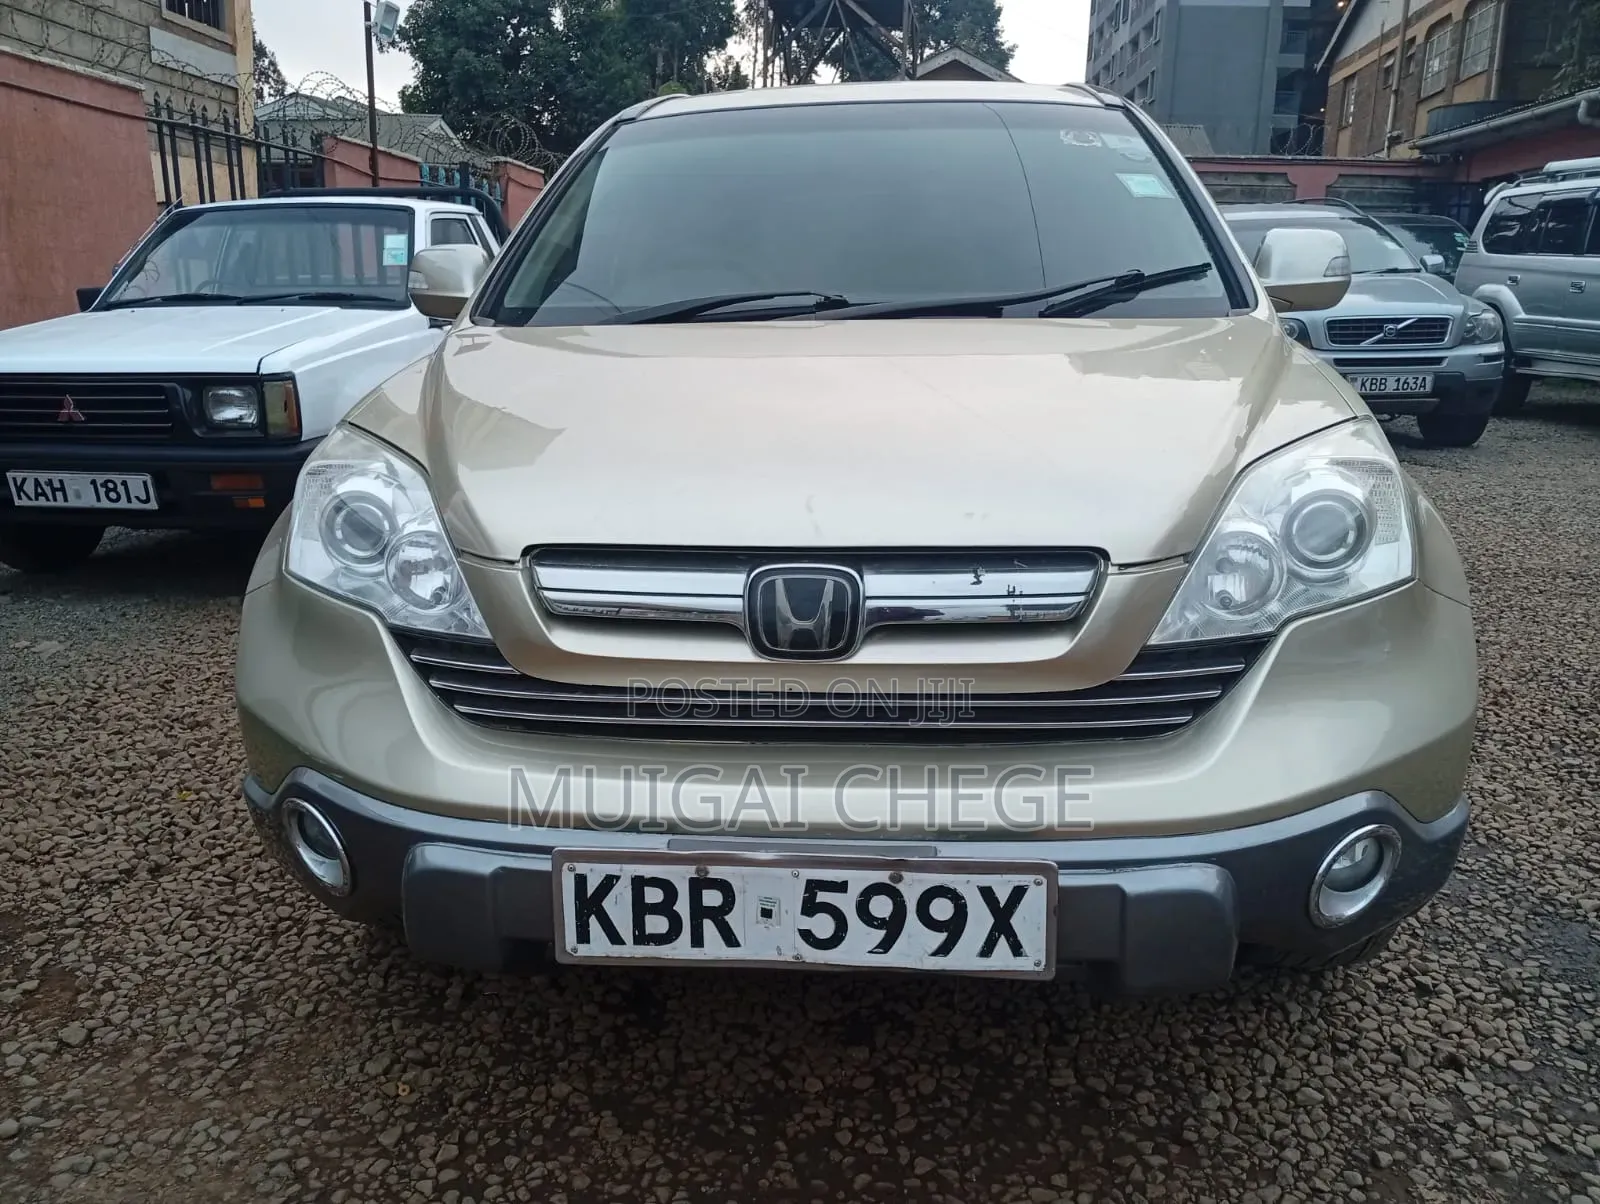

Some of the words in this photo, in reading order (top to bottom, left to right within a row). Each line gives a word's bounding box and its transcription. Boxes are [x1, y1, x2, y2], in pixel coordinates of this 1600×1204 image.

[1360, 377, 1388, 392] KBB
[1392, 376, 1427, 391] 163A
[12, 476, 69, 503] KAH
[90, 478, 151, 505] 181J
[574, 873, 744, 949] KBR
[796, 879, 1030, 958] 599X
